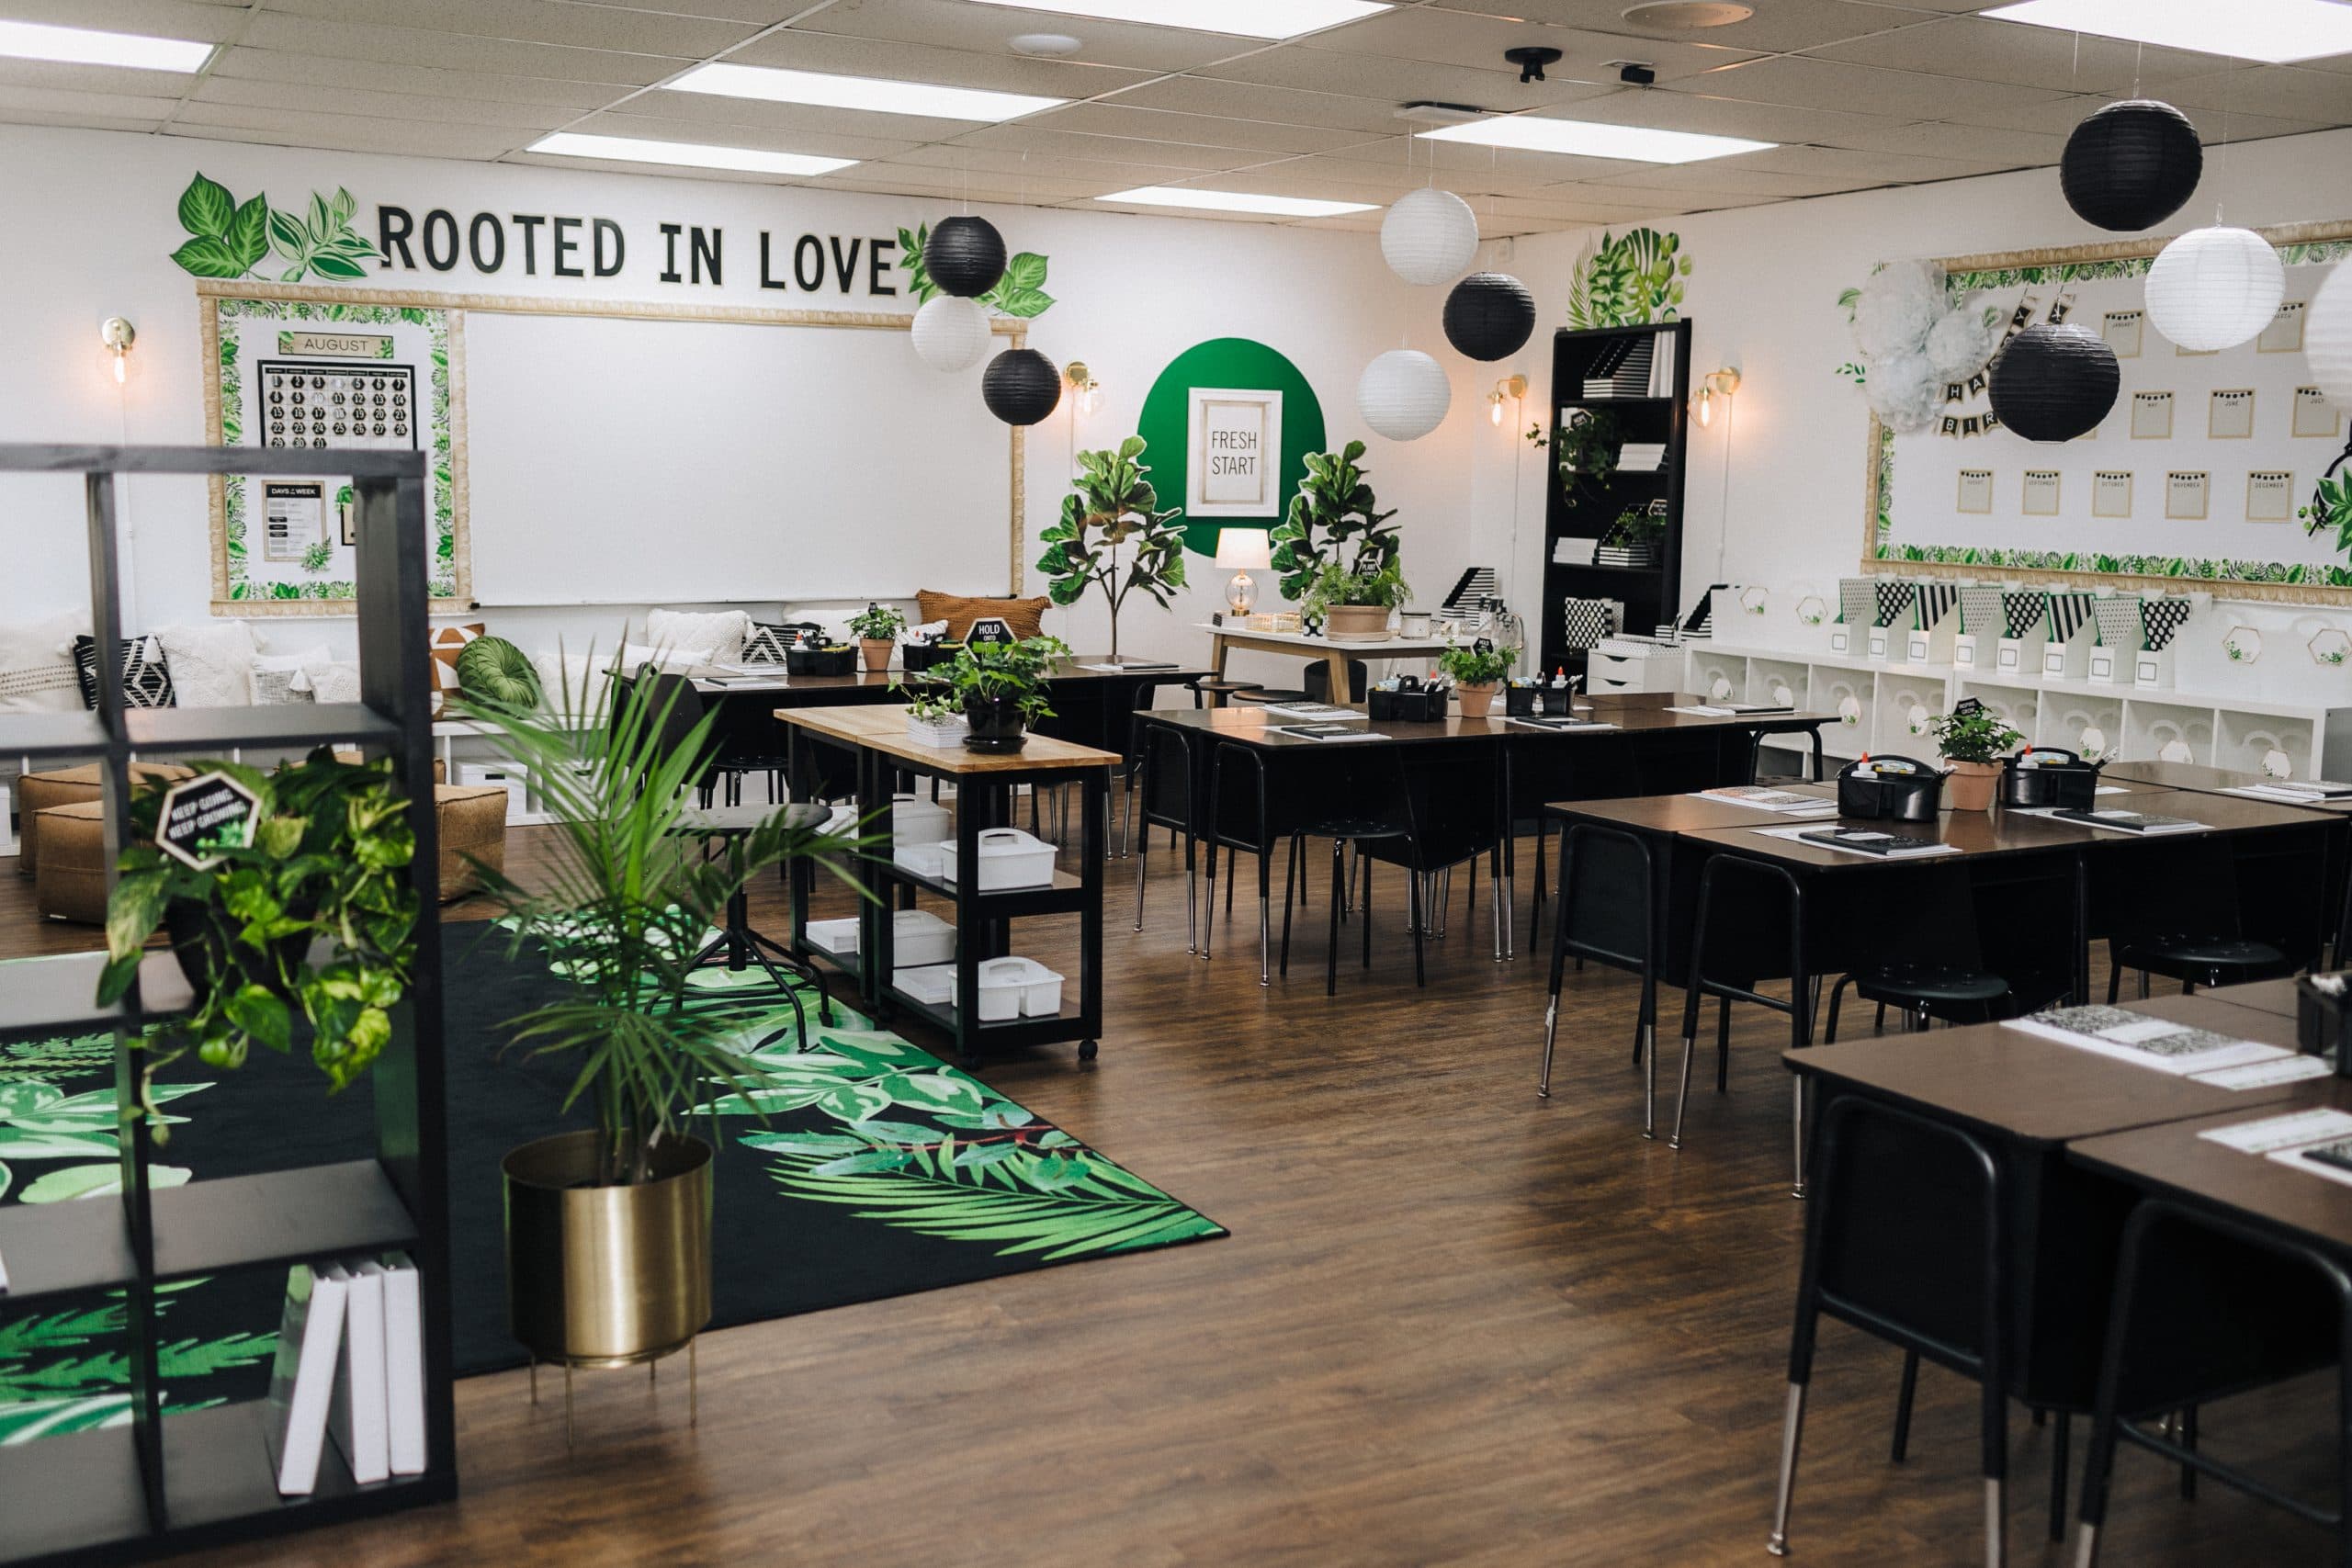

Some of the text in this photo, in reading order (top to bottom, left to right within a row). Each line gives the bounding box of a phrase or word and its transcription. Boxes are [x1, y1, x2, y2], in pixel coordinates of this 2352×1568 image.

[378, 205, 897, 296] ROOTED IN LOVE
[304, 338, 368, 352] AUGUST
[335, 394, 343, 403] 11
[355, 394, 363, 403] 12
[376, 396, 384, 404] 13
[396, 396, 404, 404] 14
[274, 408, 282, 417] 15
[295, 409, 303, 417] 16
[315, 409, 323, 418] 17
[356, 410, 364, 419] 19
[376, 411, 384, 419] 20
[396, 411, 403, 419] 21
[273, 423, 282, 433] 22
[295, 424, 303, 433] 23
[335, 424, 345, 433] 25
[356, 425, 364, 434] 26
[376, 425, 384, 434] 27
[397, 425, 405, 434] 28
[315, 439, 324, 448] 31
[1212, 431, 1257, 450] FRESH
[1212, 456, 1257, 476] START
[978, 625, 1001, 635] HOLD
